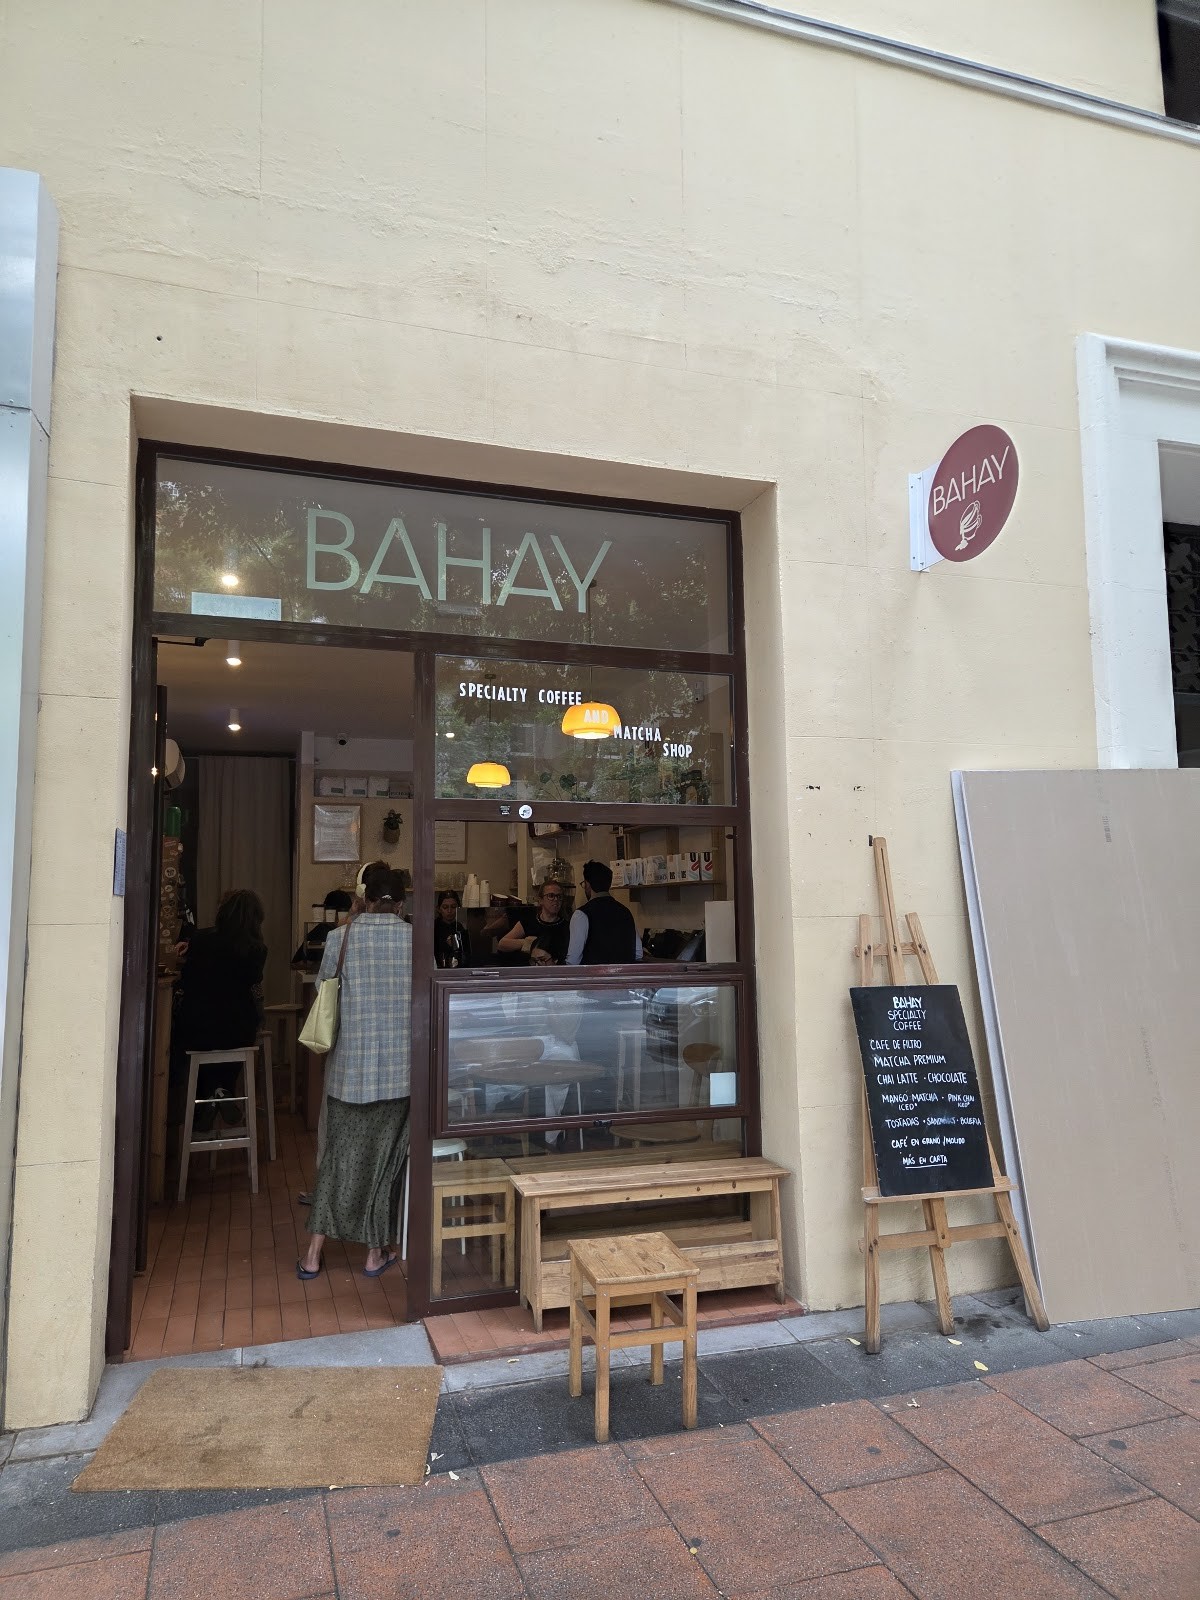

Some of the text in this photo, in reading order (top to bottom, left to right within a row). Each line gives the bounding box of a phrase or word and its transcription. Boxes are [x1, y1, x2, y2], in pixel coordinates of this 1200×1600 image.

[933, 445, 1010, 516] BAHAY
[306, 507, 613, 614] BAHAY
[459, 682, 582, 706] SPECIALTY COFFEE
[583, 709, 609, 724] AND
[613, 725, 661, 742] MATCHA
[663, 742, 693, 758] SHOP
[892, 996, 922, 1009] BAHAY
[887, 1009, 927, 1020] SPECIALTY
[893, 1020, 922, 1031] COFFEE
[892, 1039, 901, 1050] DE
[902, 1039, 922, 1050] FILTRO
[873, 1054, 947, 1068] MATCHA PREMIUM
[877, 1072, 968, 1085] CHAI LATTE CHOCOLATE
[881, 1094, 909, 1104] MANGO
[911, 1093, 939, 1103] MATCHA
[885, 1117, 920, 1129] TOSTADAS
[891, 1136, 908, 1149] CAFÉ
[911, 1138, 920, 1147] EN
[921, 1137, 941, 1146] GRANO
[902, 1154, 948, 1165] MÁS EN CARTA
